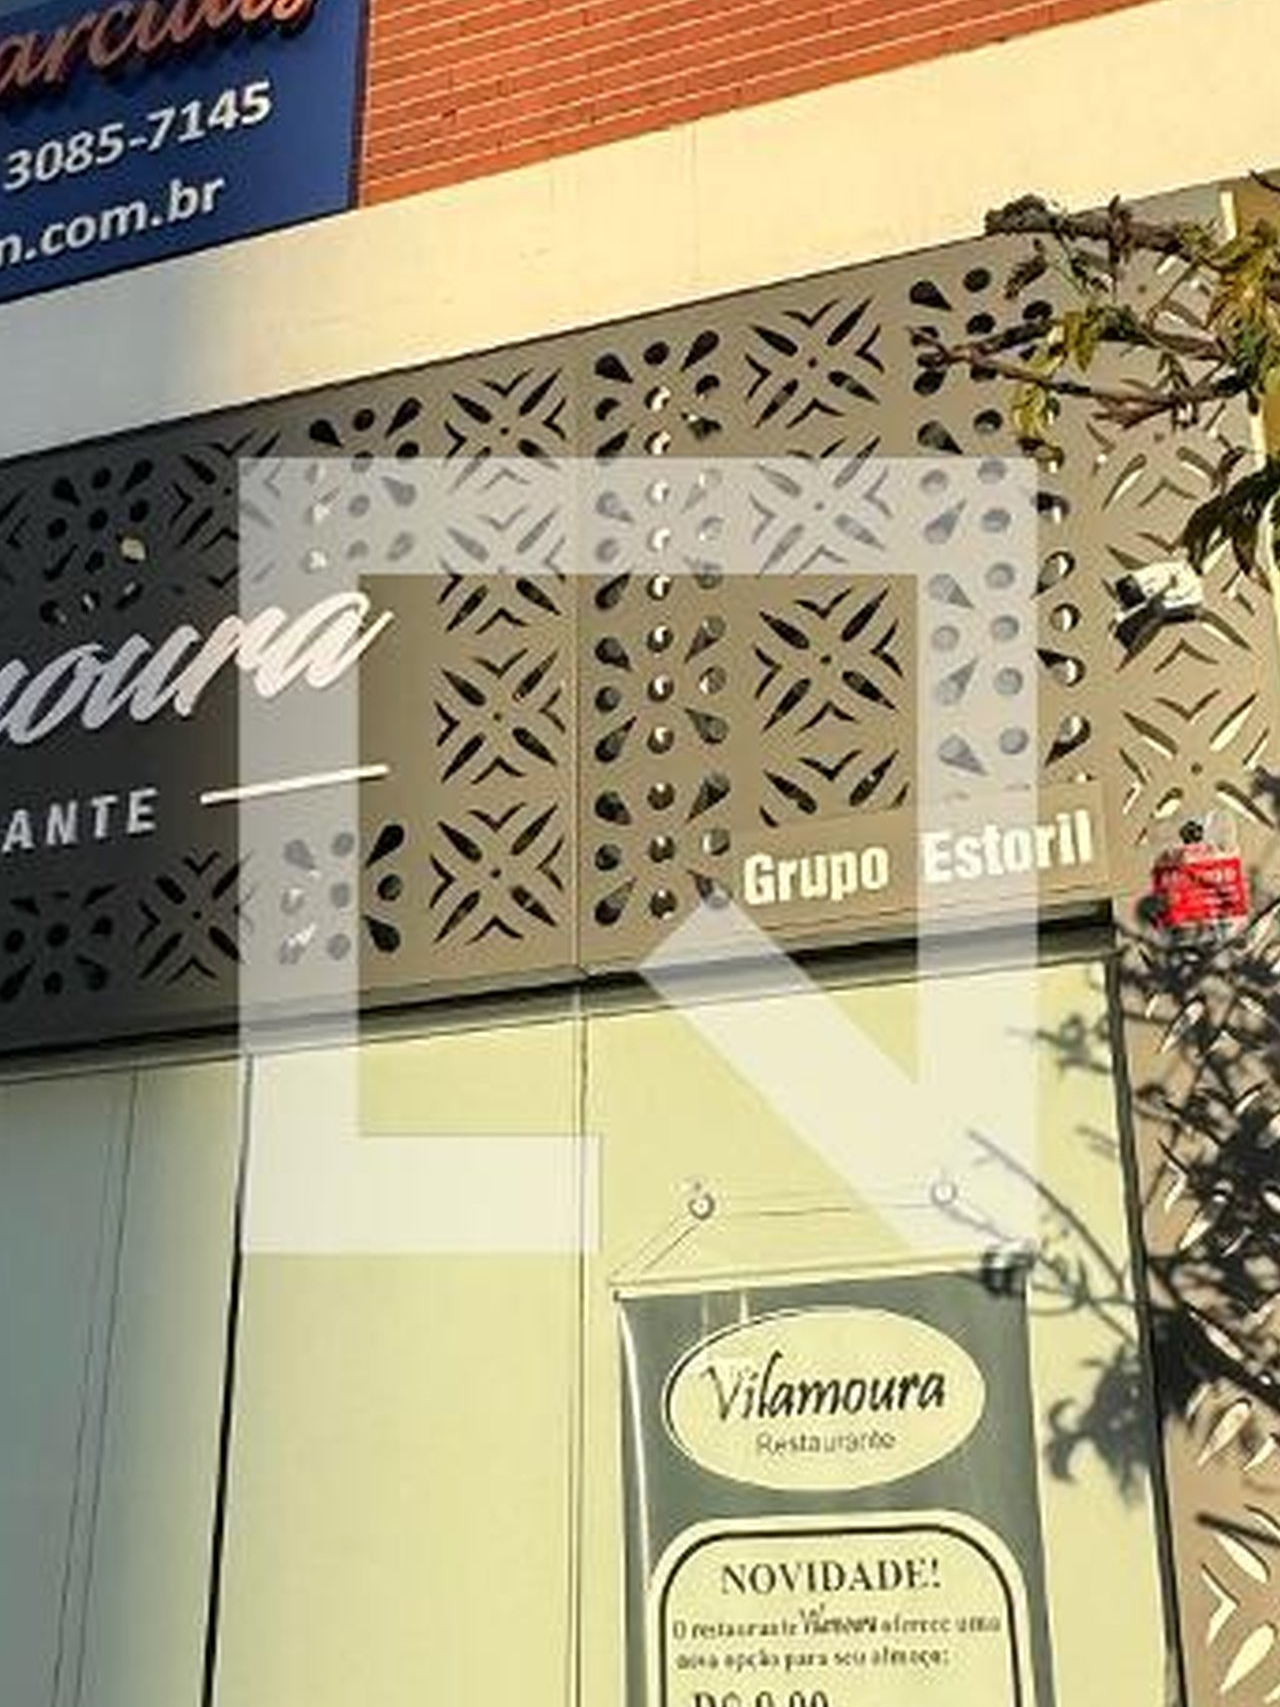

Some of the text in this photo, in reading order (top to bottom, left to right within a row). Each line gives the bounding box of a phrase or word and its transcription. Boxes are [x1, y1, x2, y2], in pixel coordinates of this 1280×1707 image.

[3, 80, 273, 193] 3085-7145
[743, 809, 1096, 907] Grupo Estoril
[700, 1349, 946, 1422] Vilamoura
[755, 1429, 897, 1457] Restaurante
[720, 1558, 942, 1594] NOVIDADE!
[692, 1617, 798, 1640] restaurante
